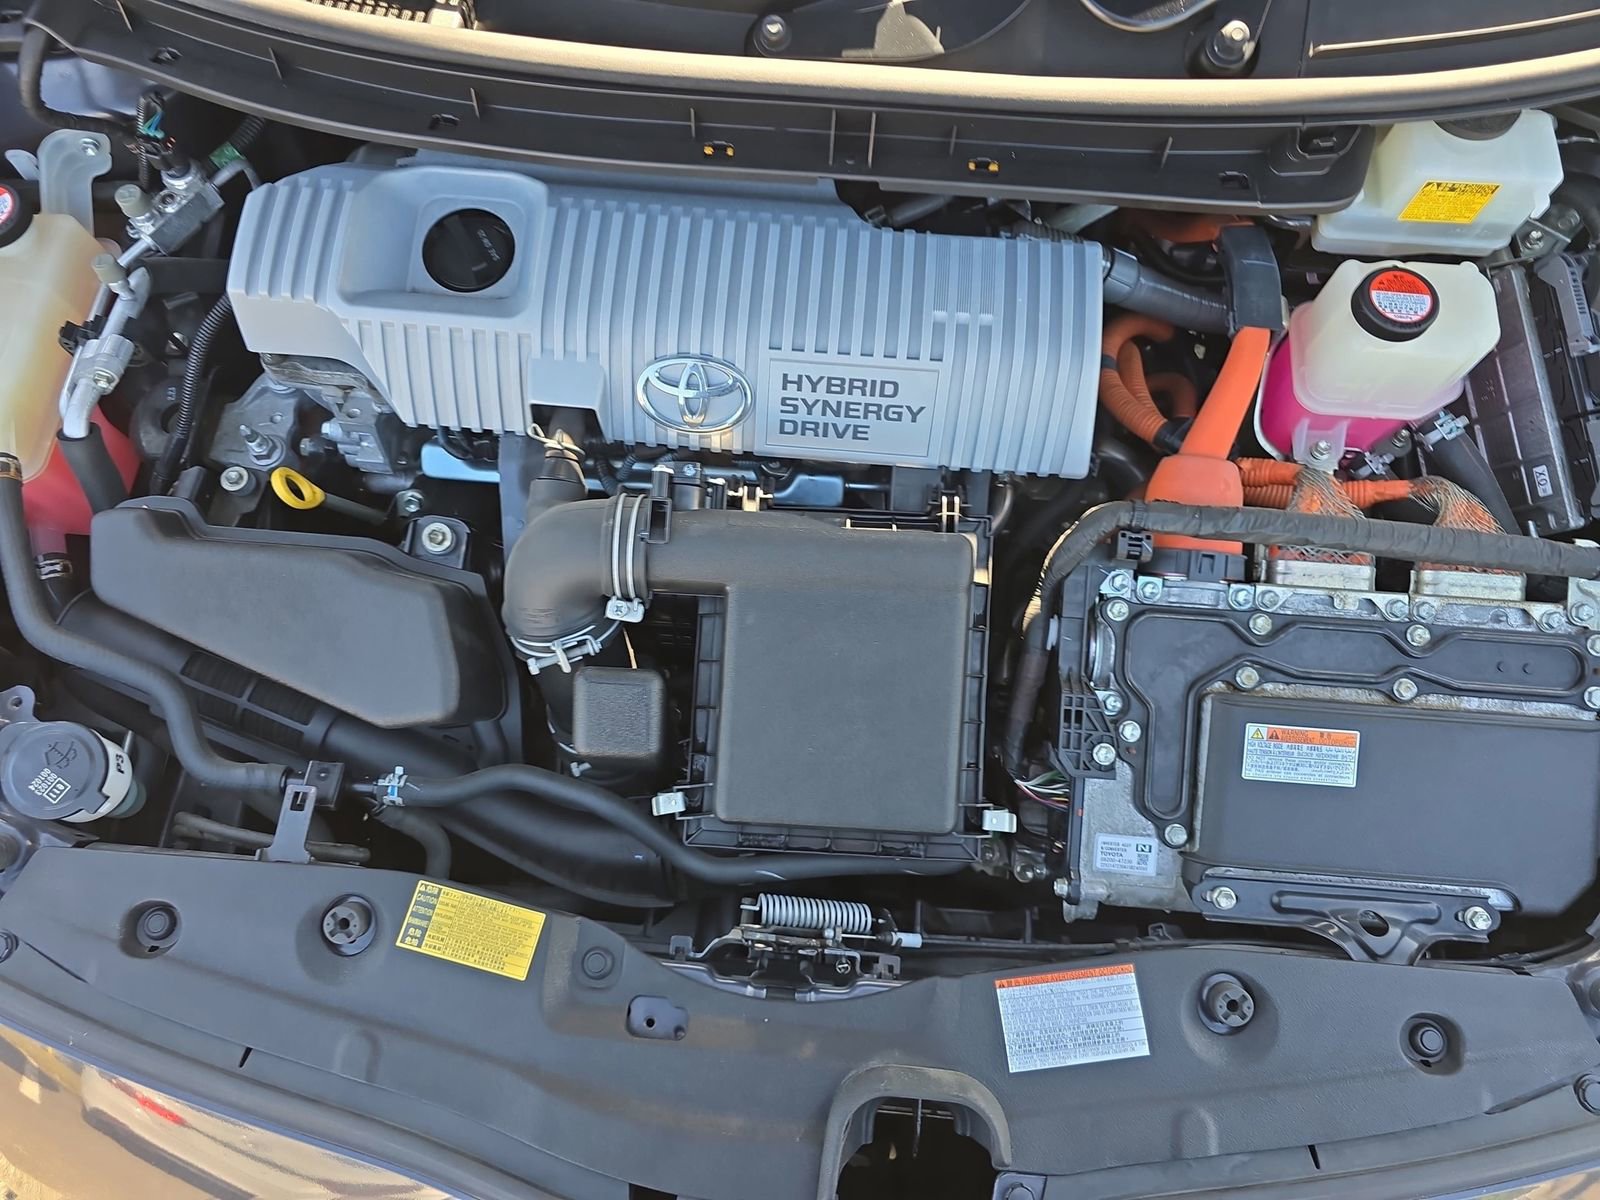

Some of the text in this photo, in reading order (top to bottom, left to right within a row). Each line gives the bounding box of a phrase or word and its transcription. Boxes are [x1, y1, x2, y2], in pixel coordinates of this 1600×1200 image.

[781, 373, 899, 399] HYBRID
[780, 396, 926, 423] SYNERGY
[779, 419, 870, 441] DRIVE
[416, 893, 437, 904] CAUTION
